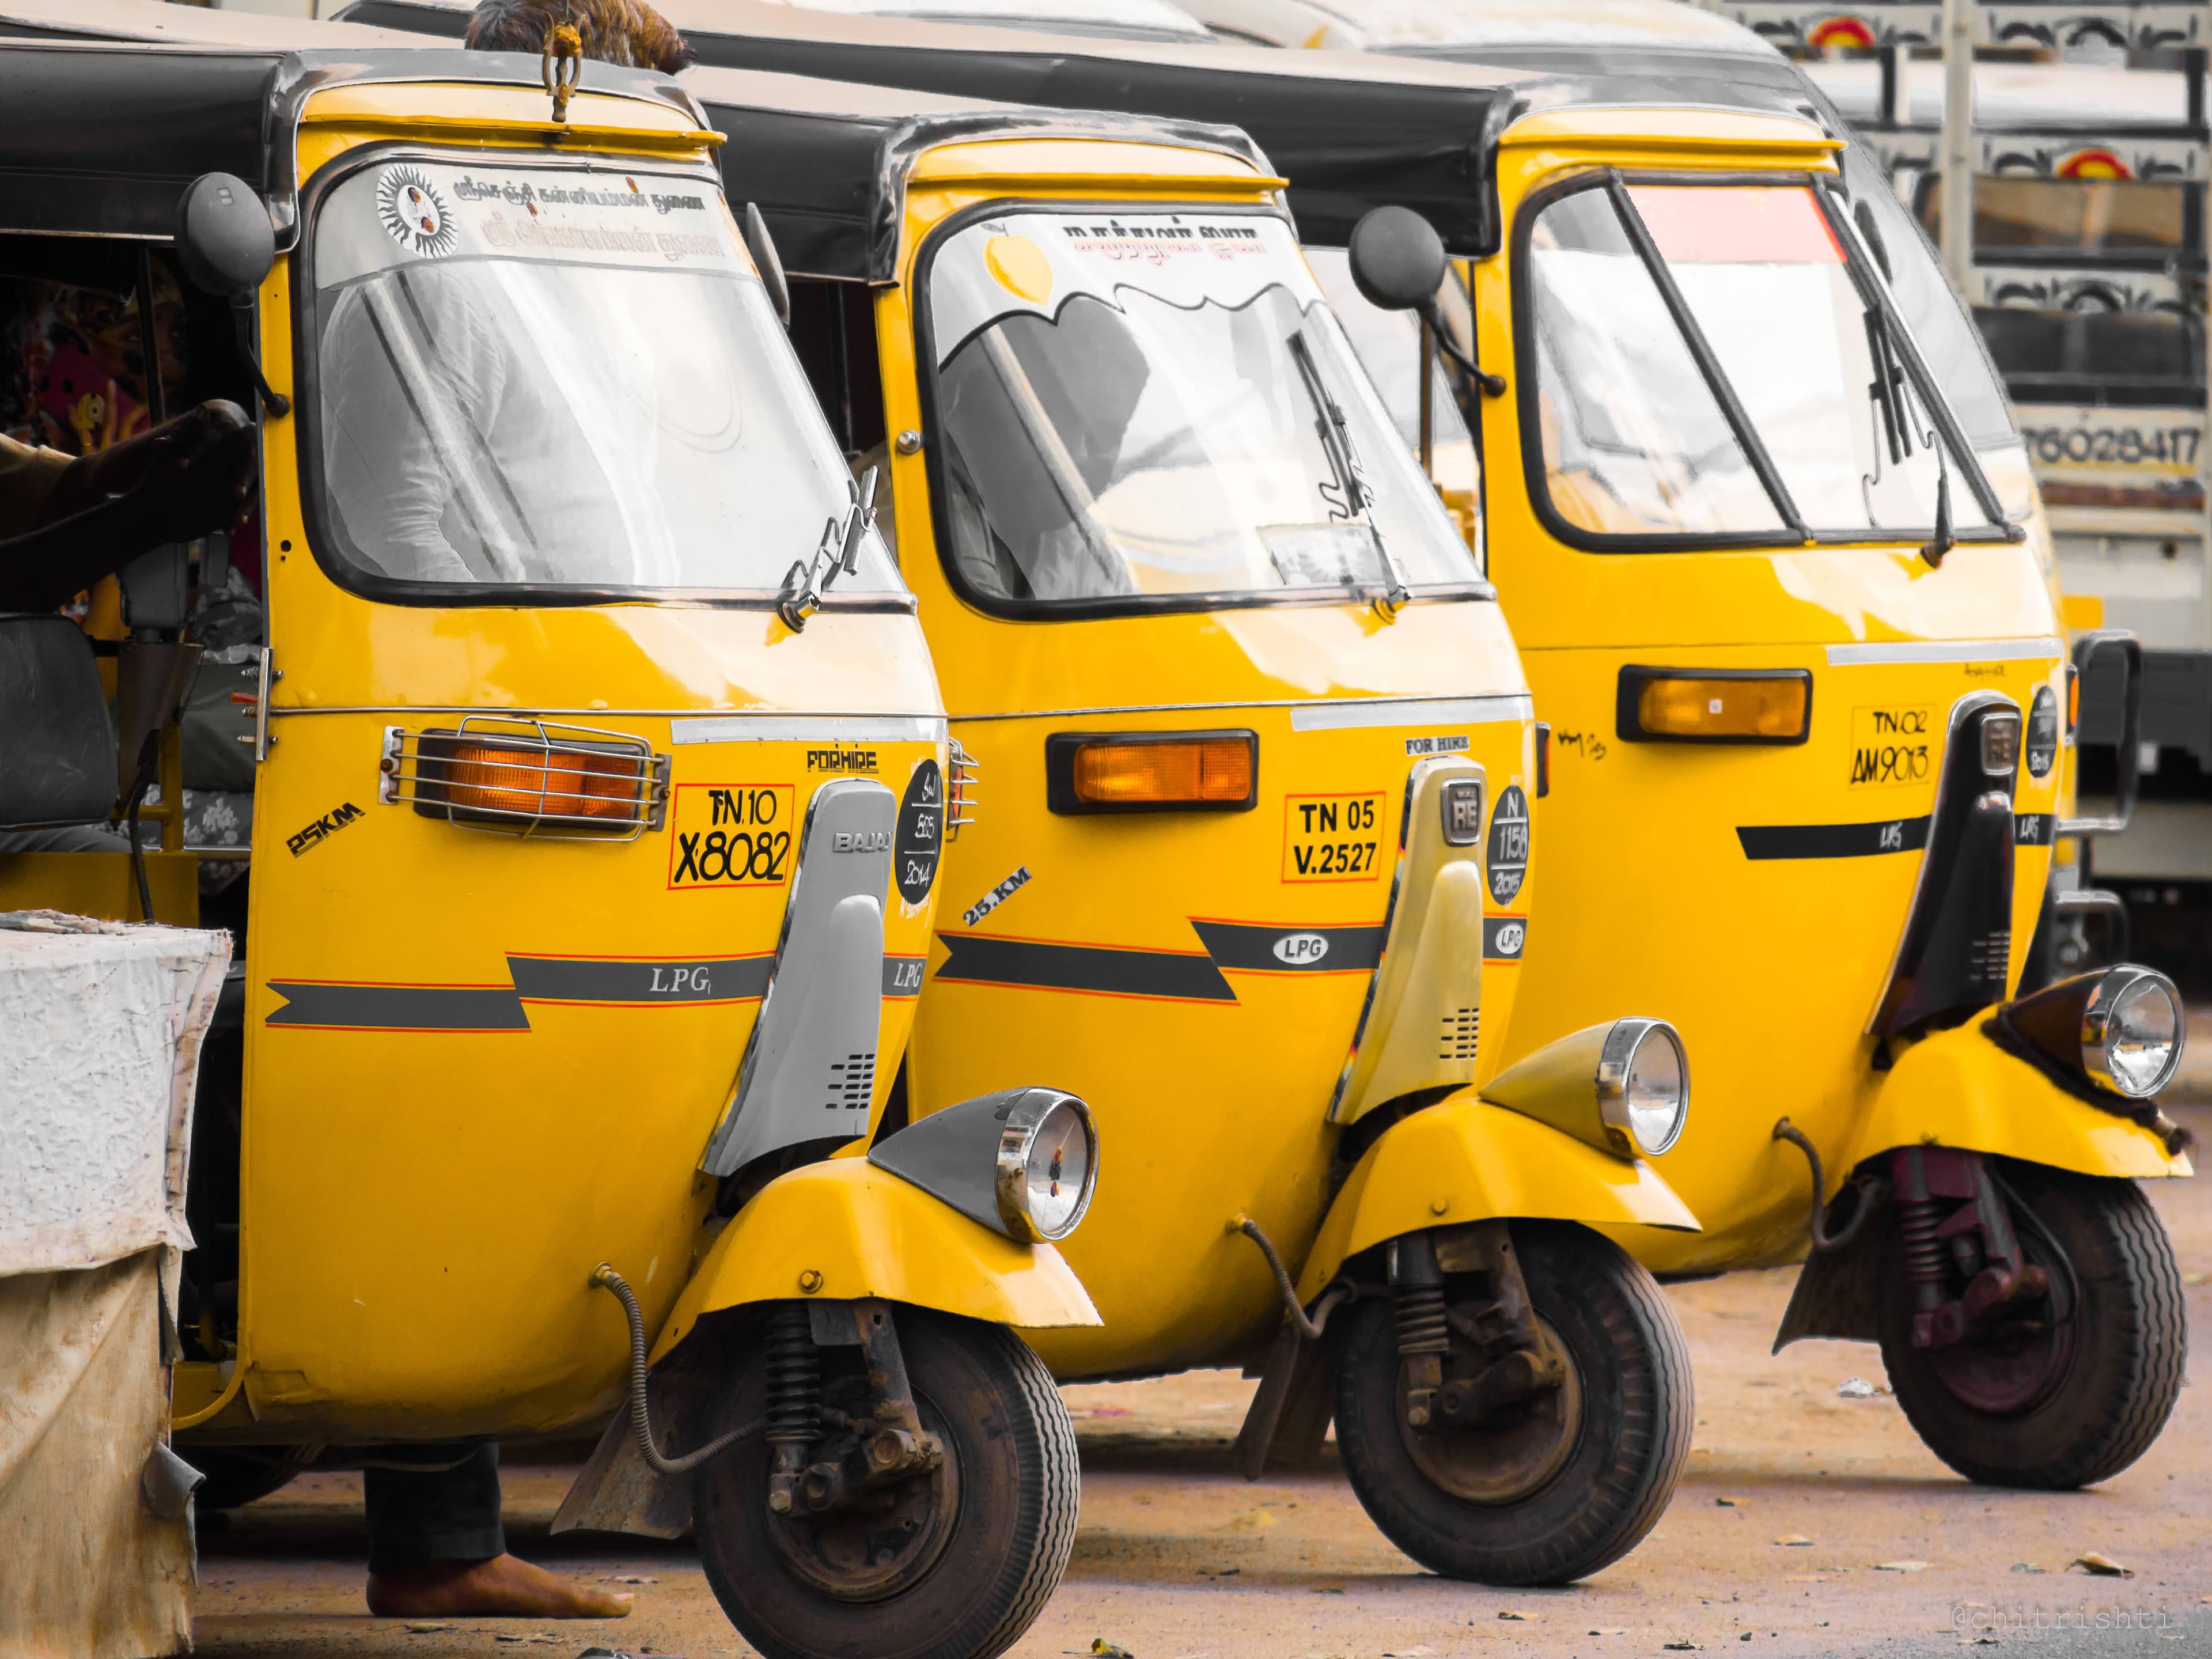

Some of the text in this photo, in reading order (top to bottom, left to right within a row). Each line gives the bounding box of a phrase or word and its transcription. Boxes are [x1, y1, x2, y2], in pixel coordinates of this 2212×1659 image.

[1406, 736, 1468, 755] FOR HIRE
[1508, 792, 1519, 817] N
[1299, 800, 1374, 834] TN 05
[833, 831, 892, 853] BAJAJ
[1294, 842, 1376, 874] V.2527
[1494, 872, 1521, 895] 2015
[1285, 939, 1321, 957] LPG
[1501, 930, 1521, 946] LPG
[649, 967, 711, 995] LPG
[893, 963, 922, 987] LPG
